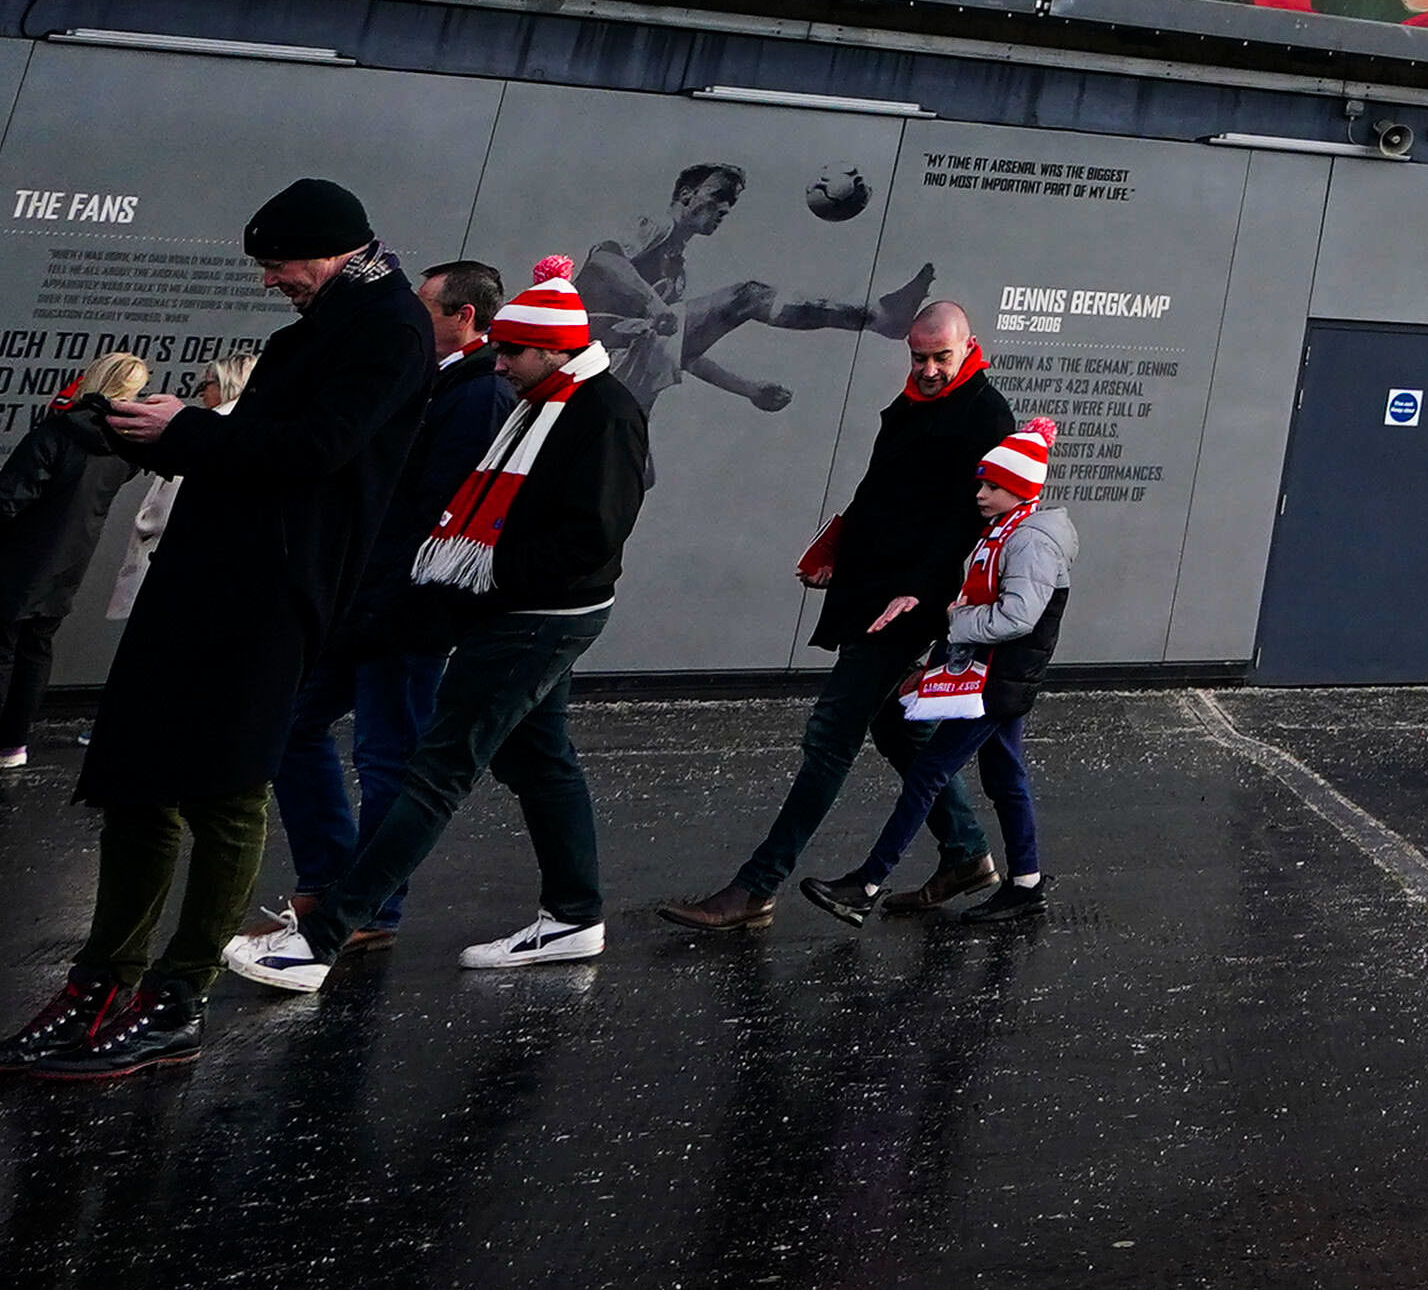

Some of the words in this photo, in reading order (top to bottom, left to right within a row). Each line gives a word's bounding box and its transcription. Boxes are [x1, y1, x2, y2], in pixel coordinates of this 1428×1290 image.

[947, 155, 972, 169] TIME
[973, 157, 988, 170] AT
[990, 158, 1036, 176] ARSENAL
[1040, 163, 1063, 178] WAS
[1066, 165, 1086, 179] THE
[1086, 166, 1130, 183] BIGGEST
[924, 171, 947, 187] AND
[949, 174, 980, 189] MOST
[981, 176, 1042, 194] IMPORTANT
[1043, 182, 1071, 197] PART
[1073, 184, 1088, 198] OF
[1088, 185, 1106, 199] MY
[13, 189, 65, 220] THE
[68, 193, 139, 224] FANS
[1000, 286, 1067, 313] DENNIS
[1070, 290, 1171, 318] BERGKAMP
[995, 313, 1062, 333] 1995-2006
[50, 332, 90, 360] TO
[989, 354, 1034, 371] KNOWN
[1036, 356, 1053, 371] AS
[1137, 361, 1179, 377] DENNIS
[1065, 379, 1089, 395] 423
[1091, 381, 1144, 397] ARSENAL
[1072, 399, 1103, 416] WERE
[1106, 401, 1133, 417] FULL
[1137, 403, 1152, 418] OF
[1078, 422, 1119, 439] GOALS.
[1096, 444, 1123, 460] AND
[1069, 465, 1165, 482] PERFORMANCES.
[1073, 485, 1128, 502] FULCRUM
[1131, 487, 1147, 502] OF
